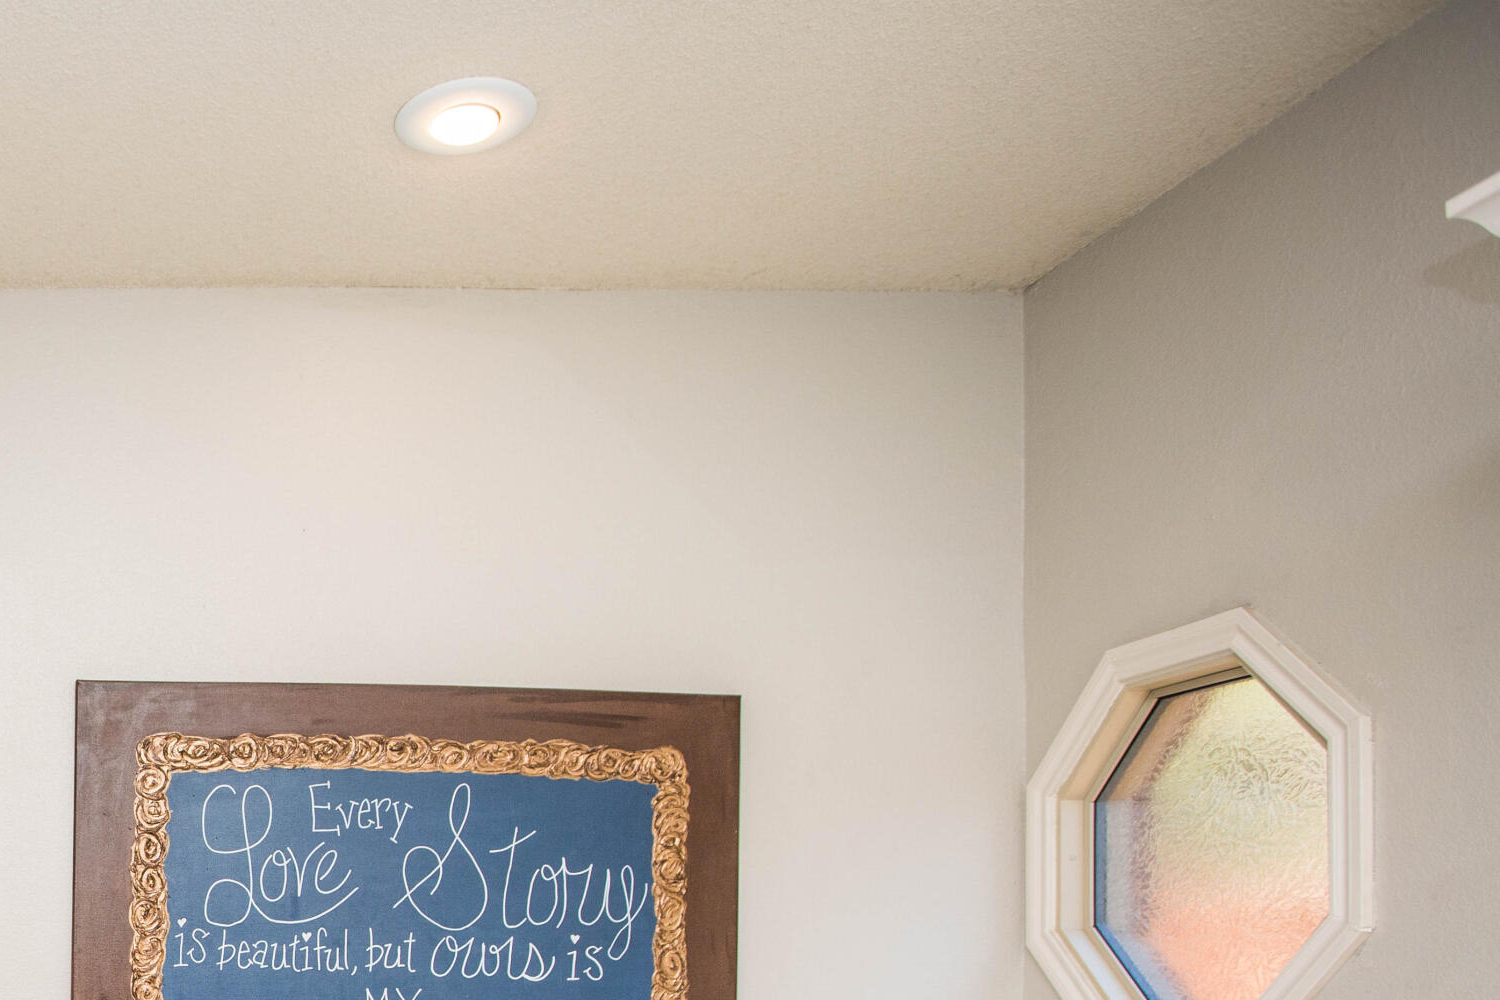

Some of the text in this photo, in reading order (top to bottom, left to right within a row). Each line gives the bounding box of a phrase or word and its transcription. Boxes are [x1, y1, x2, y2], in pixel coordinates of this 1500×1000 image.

[308, 780, 414, 844] Every
[201, 782, 649, 961] Love Story
[173, 917, 604, 982] is beautiful, but ours is
